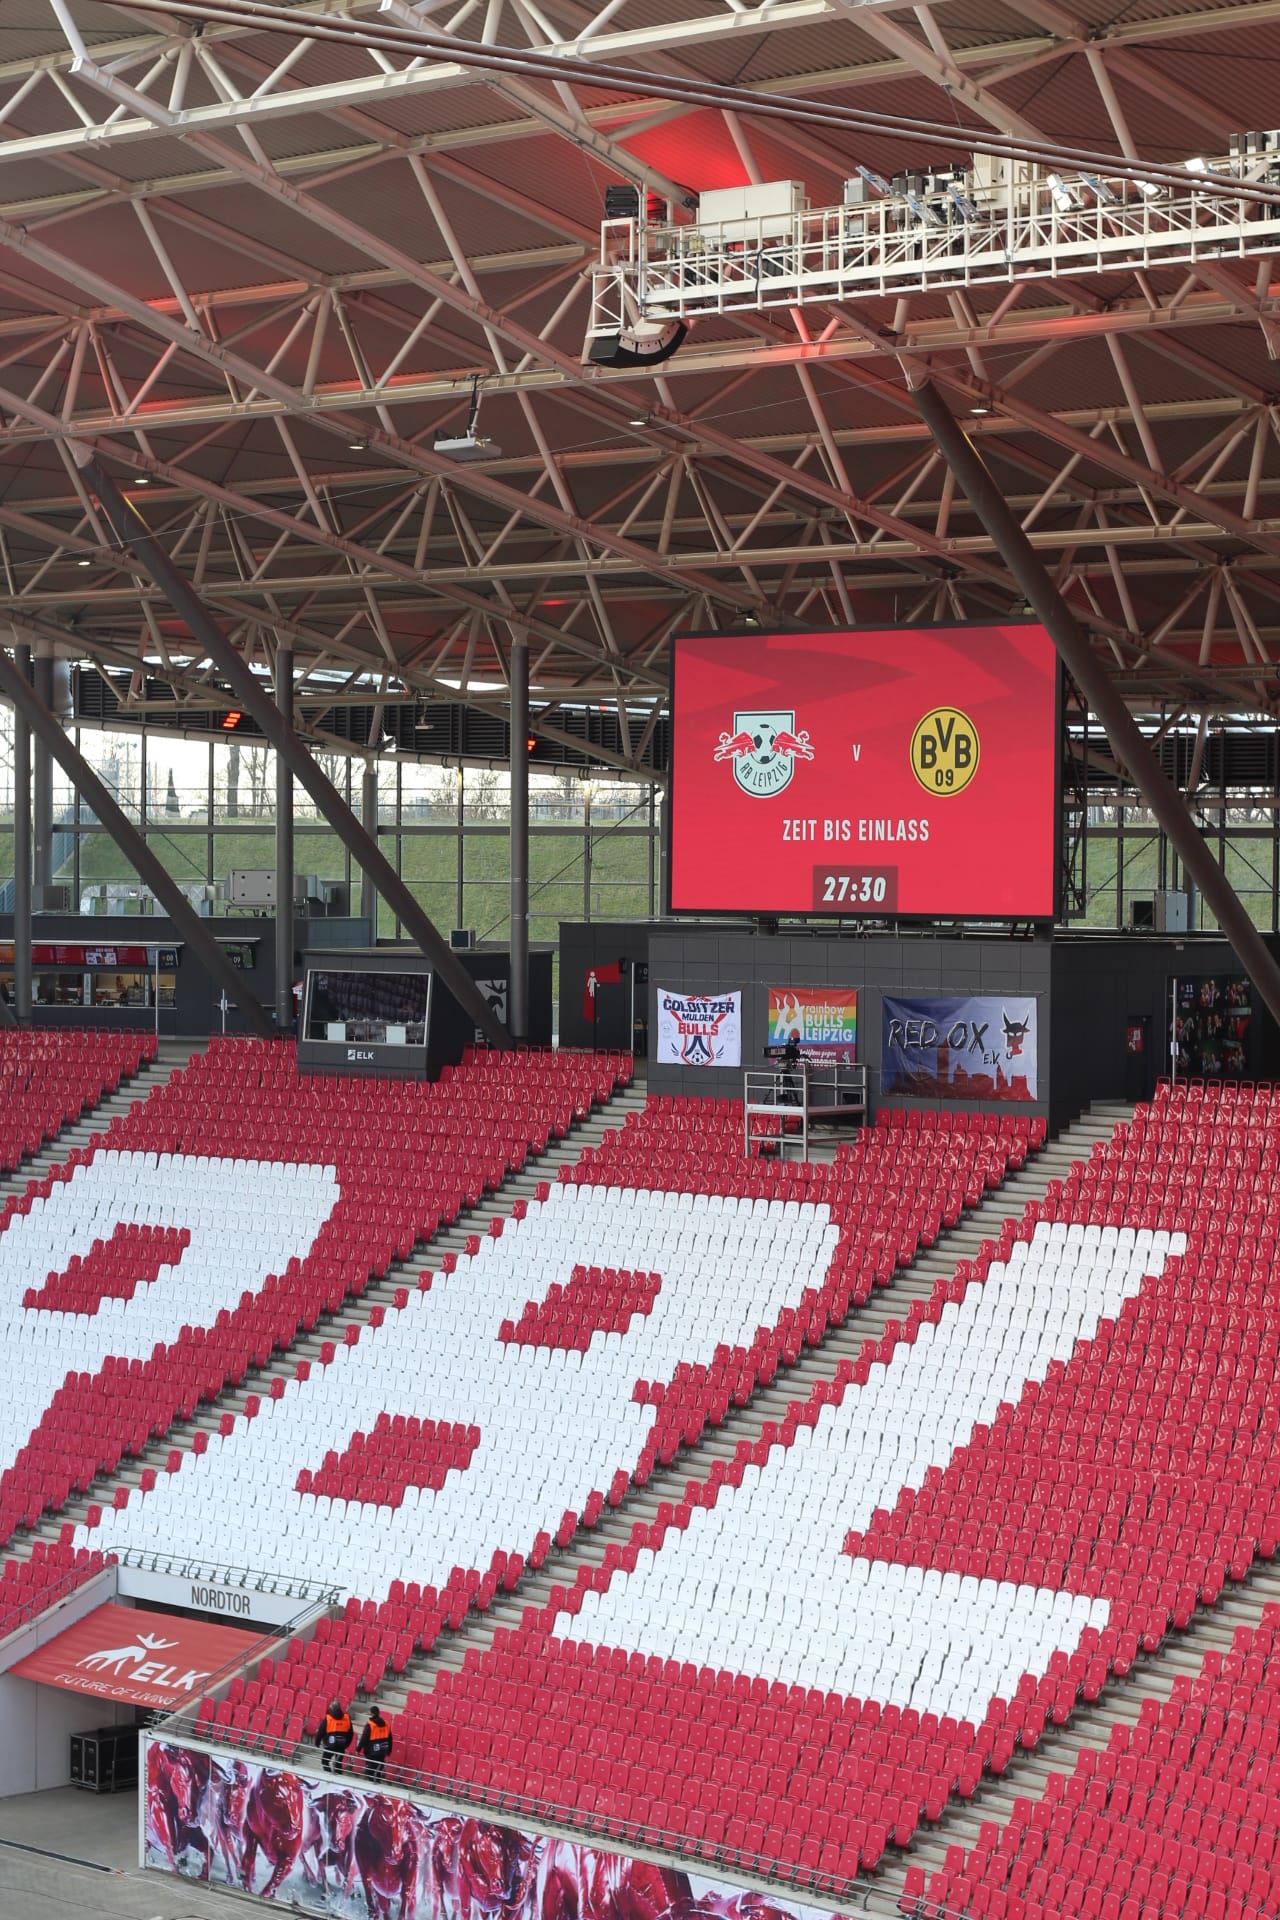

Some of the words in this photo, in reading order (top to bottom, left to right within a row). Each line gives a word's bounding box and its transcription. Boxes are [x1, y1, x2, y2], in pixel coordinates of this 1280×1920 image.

[920, 717, 971, 769] BVB
[739, 762, 753, 780] RB
[752, 760, 788, 787] LEIPZIG
[935, 768, 954, 787] 09
[782, 819, 817, 841] ZEIT
[823, 819, 851, 841] BIS
[858, 819, 929, 841] EINLASS
[822, 876, 887, 902] 27:30
[663, 998, 735, 1013] COLDITZER
[806, 1000, 845, 1015] rainbow
[682, 1013, 715, 1022] MULDEN
[806, 1014, 844, 1028] BULLS
[678, 1022, 719, 1036] BULLS
[806, 1028, 852, 1042] LEIPZIG
[888, 1018, 939, 1050] RED
[946, 1020, 990, 1054] OX
[356, 1051, 374, 1060] ELK
[191, 1586, 251, 1615] NORDTOR
[128, 1661, 212, 1691] ELK
[54, 1673, 109, 1693] FUTURE
[111, 1686, 135, 1696] OF
[131, 1690, 177, 1706] LIVING
